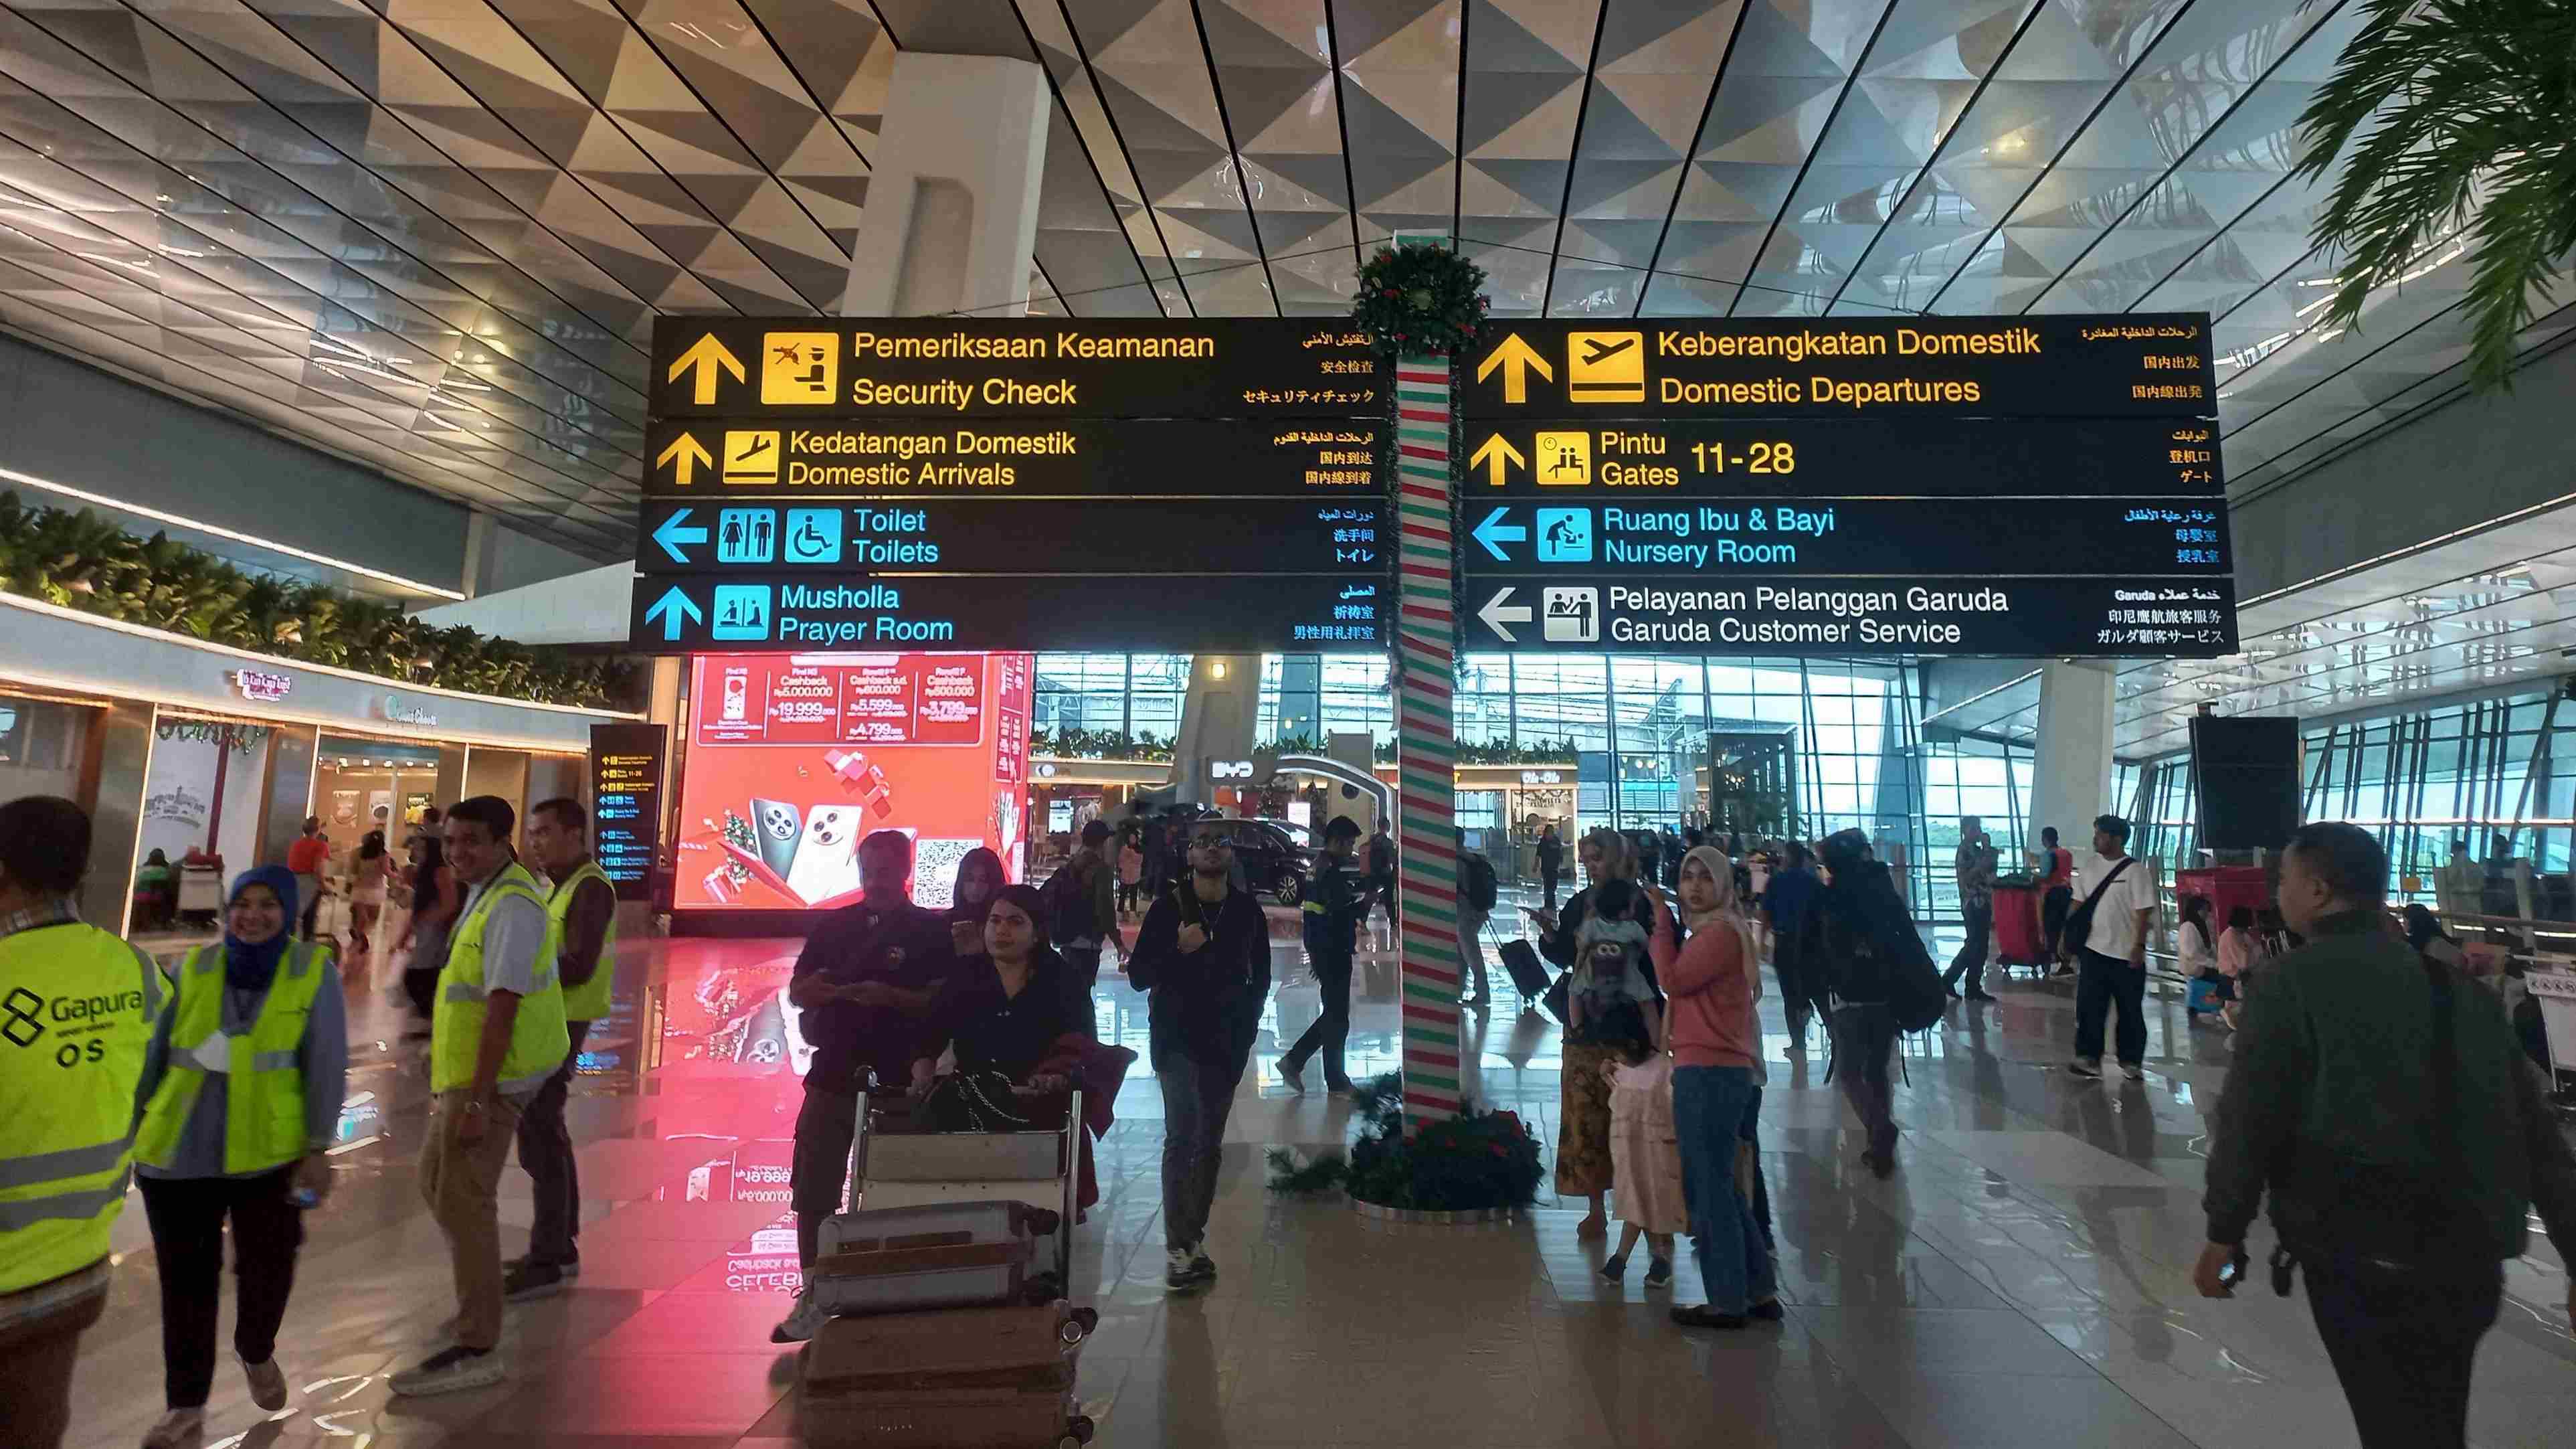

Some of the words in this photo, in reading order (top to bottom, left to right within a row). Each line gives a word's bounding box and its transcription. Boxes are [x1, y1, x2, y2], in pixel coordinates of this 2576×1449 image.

[2121, 327, 2155, 339] الداخلية
[2158, 327, 2197, 339] الرحلات
[854, 332, 1046, 358] Pemeriksaan
[1057, 333, 1214, 358] Keamanan
[1659, 330, 1885, 362] Keberangkatan
[1897, 327, 2041, 355] Domestik
[1321, 360, 1374, 373] 安全检查
[2144, 355, 2201, 369] 国内出发
[852, 378, 974, 411] Security
[983, 378, 1077, 405] Check
[1243, 390, 1374, 404] セキュリティチェック
[1661, 377, 1801, 403] Domestic
[1811, 377, 1981, 408] Departures
[2132, 385, 2203, 399] 国内線出発
[790, 430, 946, 460] Kedatangan
[956, 431, 1076, 454] Domestik
[1336, 432, 1374, 445] الرحلات
[1601, 431, 1665, 454] Pintu
[1320, 452, 1374, 465] 国内到达
[1691, 442, 1795, 474] 11-28
[2169, 449, 2211, 463] 登机口
[788, 462, 910, 485] Domestic
[917, 462, 1014, 485] Arrivals
[1305, 471, 1372, 485] 国内線到着
[1600, 461, 1679, 486] Gates
[2180, 470, 2213, 483] ゲート
[854, 509, 926, 532] Toilet
[1604, 507, 1690, 537] Ruang
[1699, 507, 1739, 531] Ibu
[1748, 508, 1768, 531] &
[1777, 507, 1835, 537] Bayi
[1333, 529, 1374, 542] 洗手间
[852, 539, 939, 563] Toilets
[1336, 548, 1375, 563] トイレ
[1605, 539, 1708, 568] Nursery
[1718, 539, 1796, 563] Room
[781, 584, 900, 609] Musholla
[1610, 586, 1746, 616] Pelayanan
[1756, 586, 1897, 616] Pelanggan
[1906, 586, 2009, 612] Garuda
[2114, 590, 2156, 601] Garuda
[2108, 609, 2221, 624] 印尼鹰航旅客服务
[779, 617, 866, 647] Prayer
[876, 616, 953, 641] Room
[1611, 617, 1712, 642] Garuda
[1720, 617, 1851, 643] Customer
[1859, 618, 1961, 643] Service
[2097, 629, 2224, 644] ガルダ顧客サービス
[780, 676, 828, 685] Cashback
[1212, 762, 1253, 778] BYD
[52, 991, 142, 1022] Gapura
